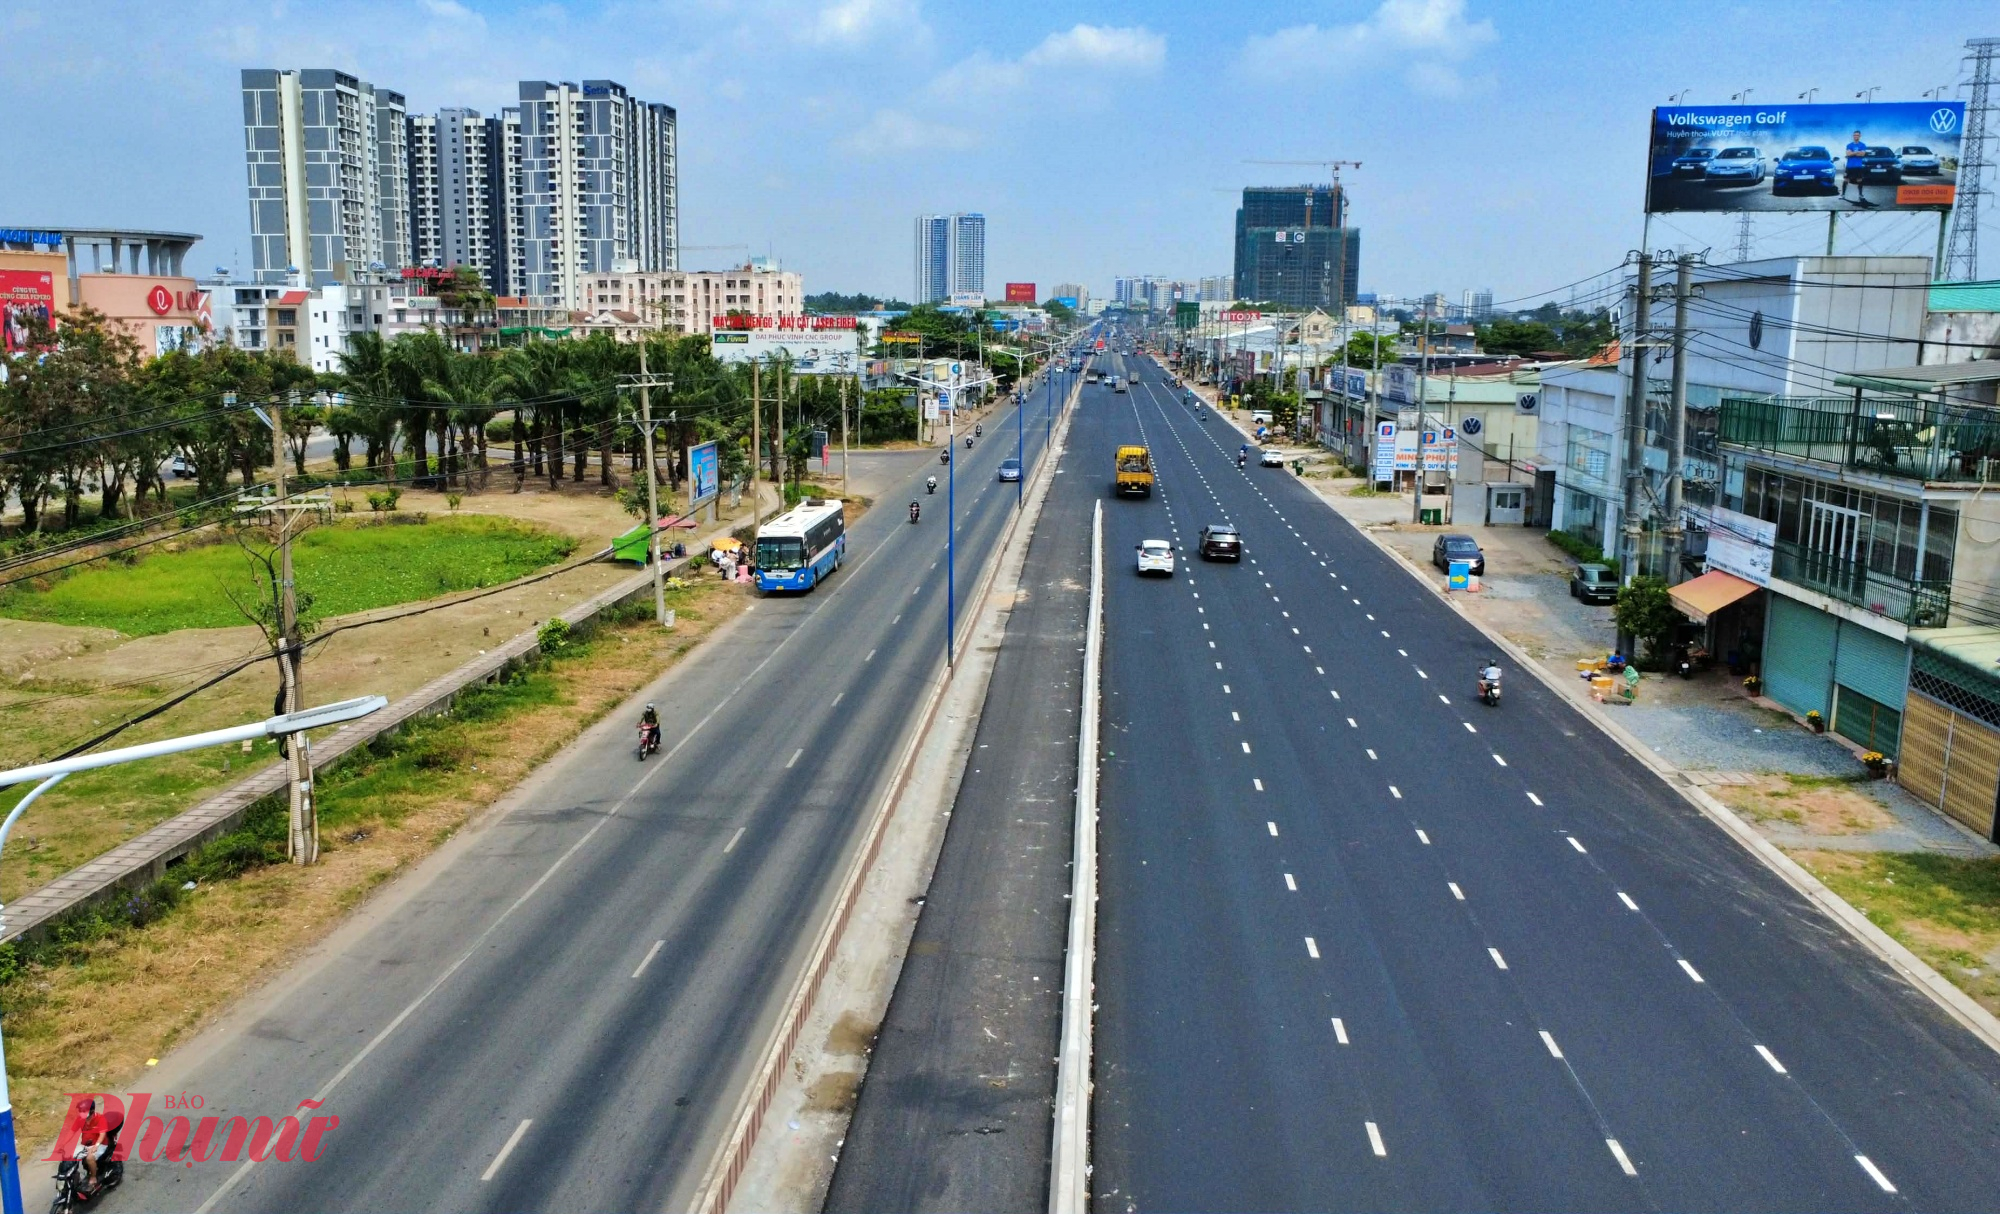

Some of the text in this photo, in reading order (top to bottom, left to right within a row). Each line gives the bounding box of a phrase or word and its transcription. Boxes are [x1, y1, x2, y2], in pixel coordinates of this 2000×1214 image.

[1668, 111, 1787, 128] Volkswagen Golf
[32, 231, 63, 245] BANK
[1396, 453, 1419, 461] MIN
